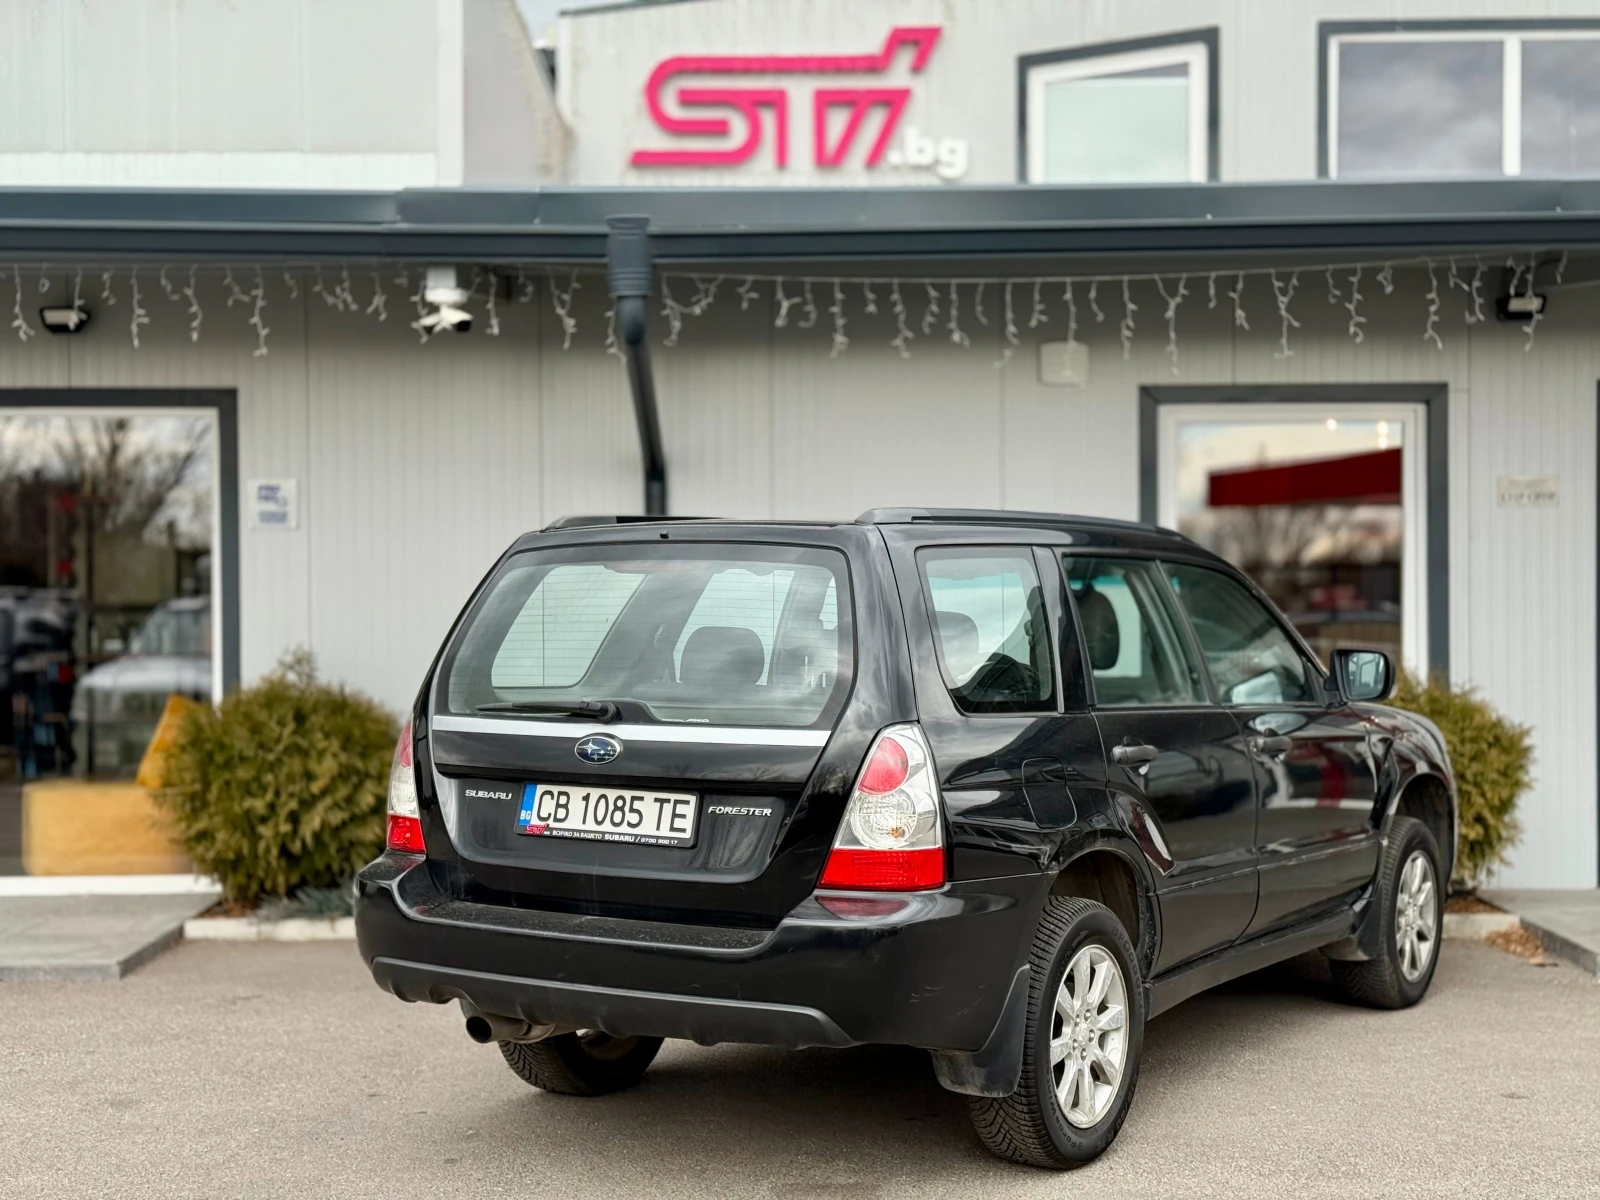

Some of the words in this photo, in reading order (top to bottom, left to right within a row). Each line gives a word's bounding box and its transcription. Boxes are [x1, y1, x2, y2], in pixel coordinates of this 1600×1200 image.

[465, 789, 512, 800] SUBARU
[520, 809, 532, 821] BG
[581, 792, 645, 829] 1085
[707, 806, 772, 817] FORESTER
[604, 833, 634, 843] SUBARU
